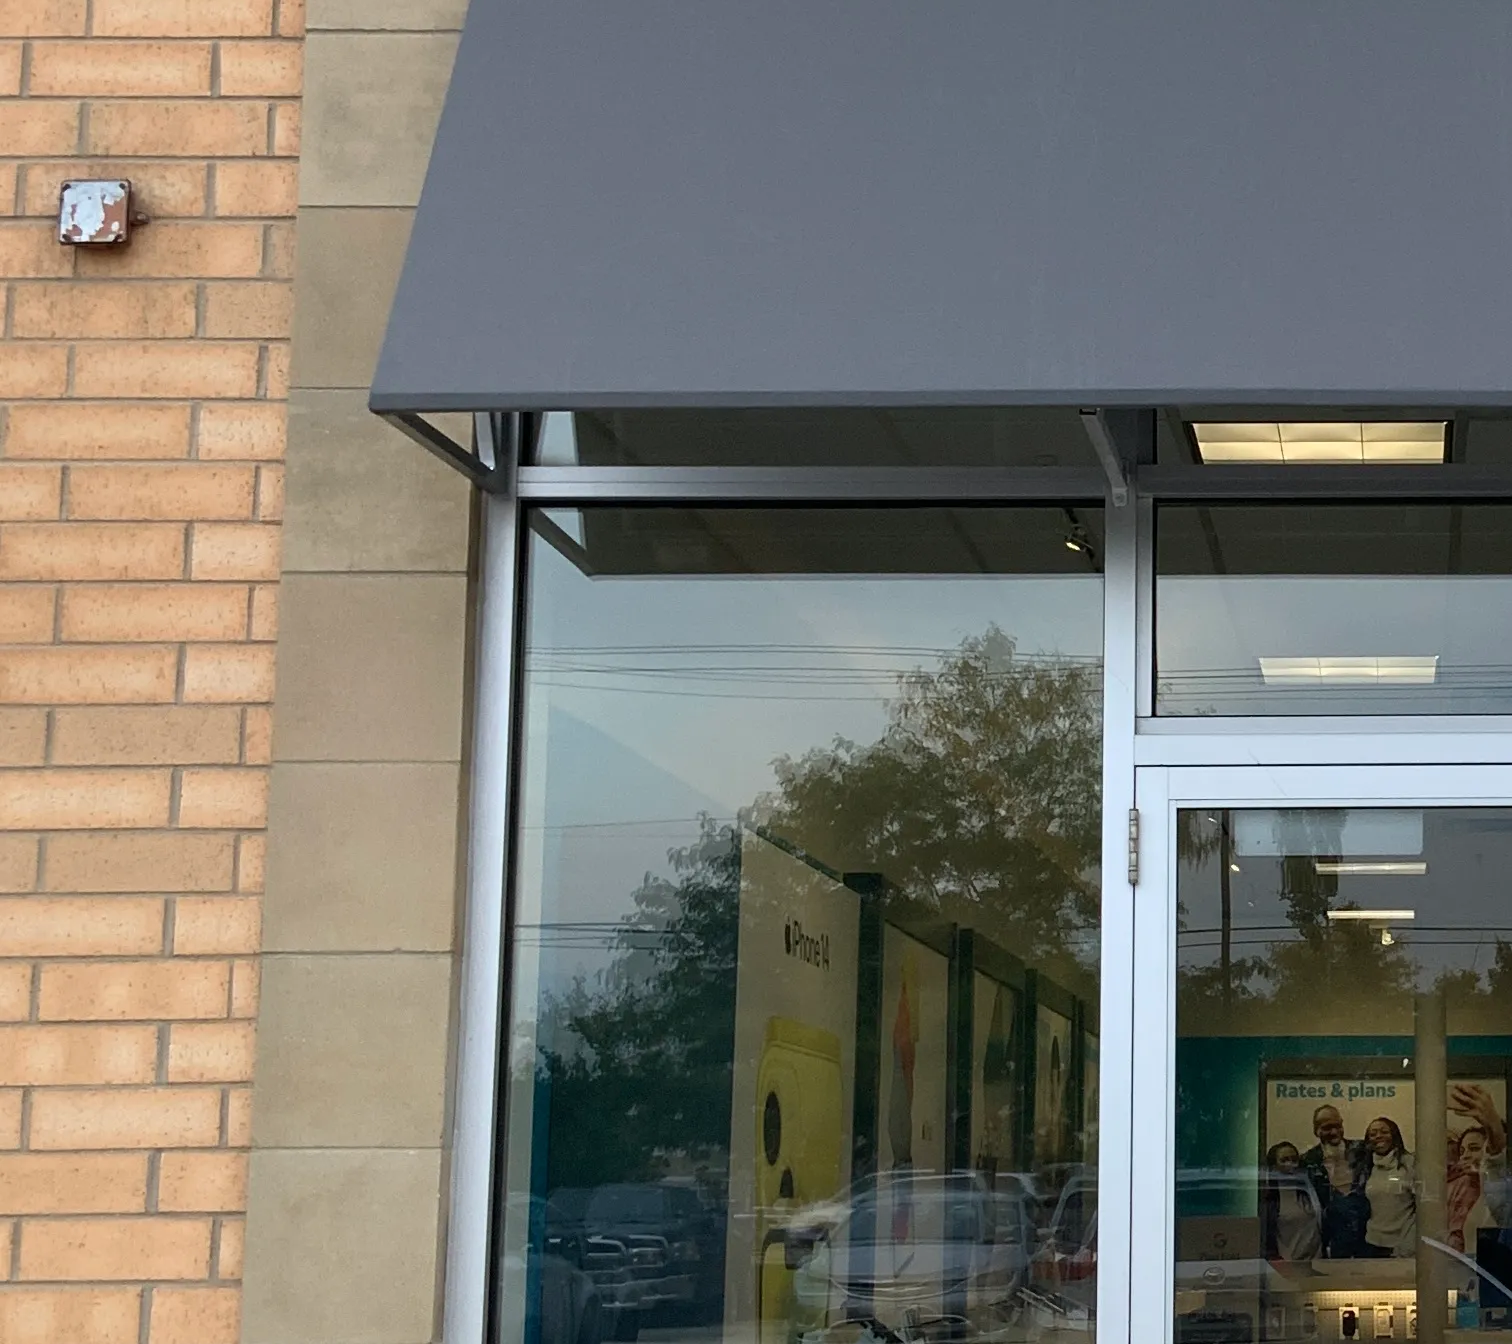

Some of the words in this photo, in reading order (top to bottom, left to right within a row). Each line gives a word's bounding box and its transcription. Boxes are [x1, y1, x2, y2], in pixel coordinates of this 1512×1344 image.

[1275, 1083, 1327, 1098] Rates
[1330, 1082, 1344, 1098] &
[1347, 1081, 1396, 1102] plans
